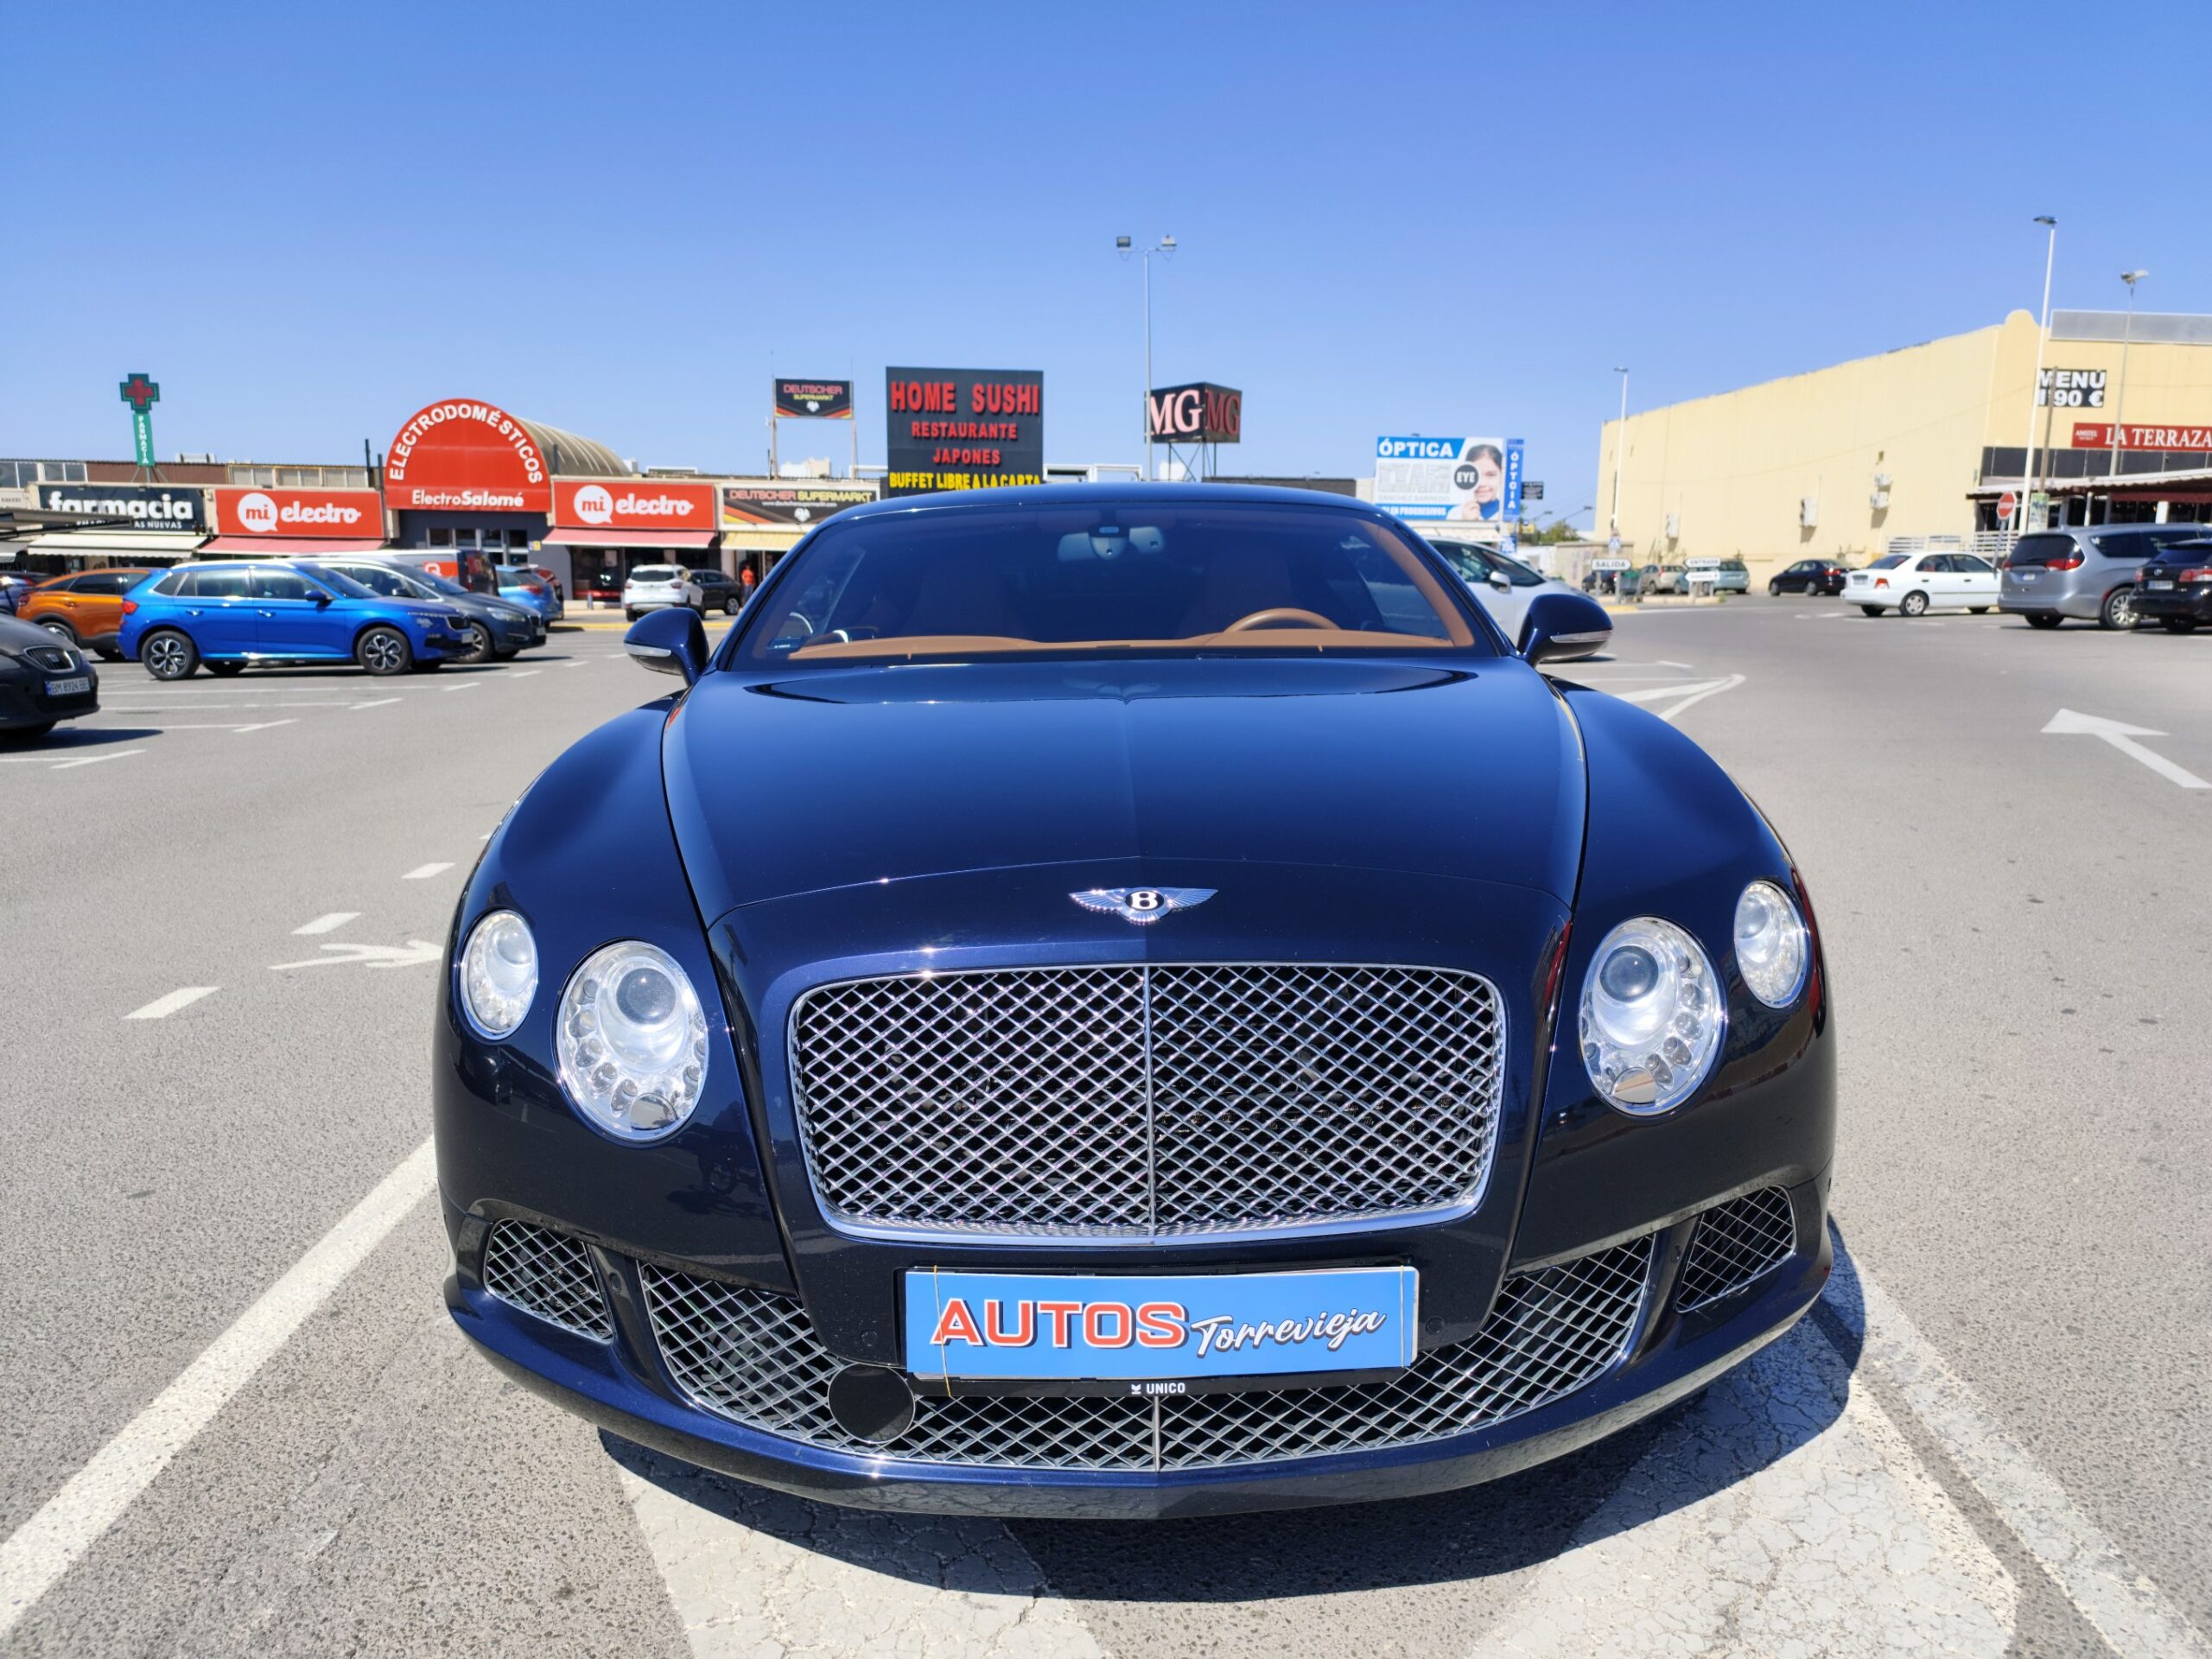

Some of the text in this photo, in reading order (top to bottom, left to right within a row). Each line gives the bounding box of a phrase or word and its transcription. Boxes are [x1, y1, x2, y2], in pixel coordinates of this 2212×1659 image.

[784, 385, 842, 394] DEUTSCHER
[2040, 371, 2106, 389] MENÚ
[891, 382, 1039, 416] HOME SUSHI
[1145, 389, 1203, 435] MG
[1205, 389, 1240, 435] MG
[138, 416, 149, 464] FARMACIA
[912, 421, 1018, 439] RESTAURANTE
[2105, 427, 2212, 448] LA TERRAZA
[390, 404, 543, 484] ELECTRODOMÉSTICOS
[1378, 438, 1453, 457] ÓPTICA
[933, 448, 1001, 465] JAPONES
[889, 473, 934, 489] BUFFET
[937, 474, 970, 491] LIBRE
[972, 474, 981, 490] A
[982, 474, 998, 487] LA
[1456, 472, 1476, 483] EYE
[49, 491, 194, 519] farmacia
[412, 490, 524, 507] ElectroSalomé
[582, 493, 694, 515] mi electro
[729, 490, 872, 503] DEUTSCHER SUPERMARKT
[245, 501, 361, 523] mi electro
[930, 1298, 1388, 1359] AUTOS Torrevieja
[1146, 1382, 1186, 1395] UNICO
